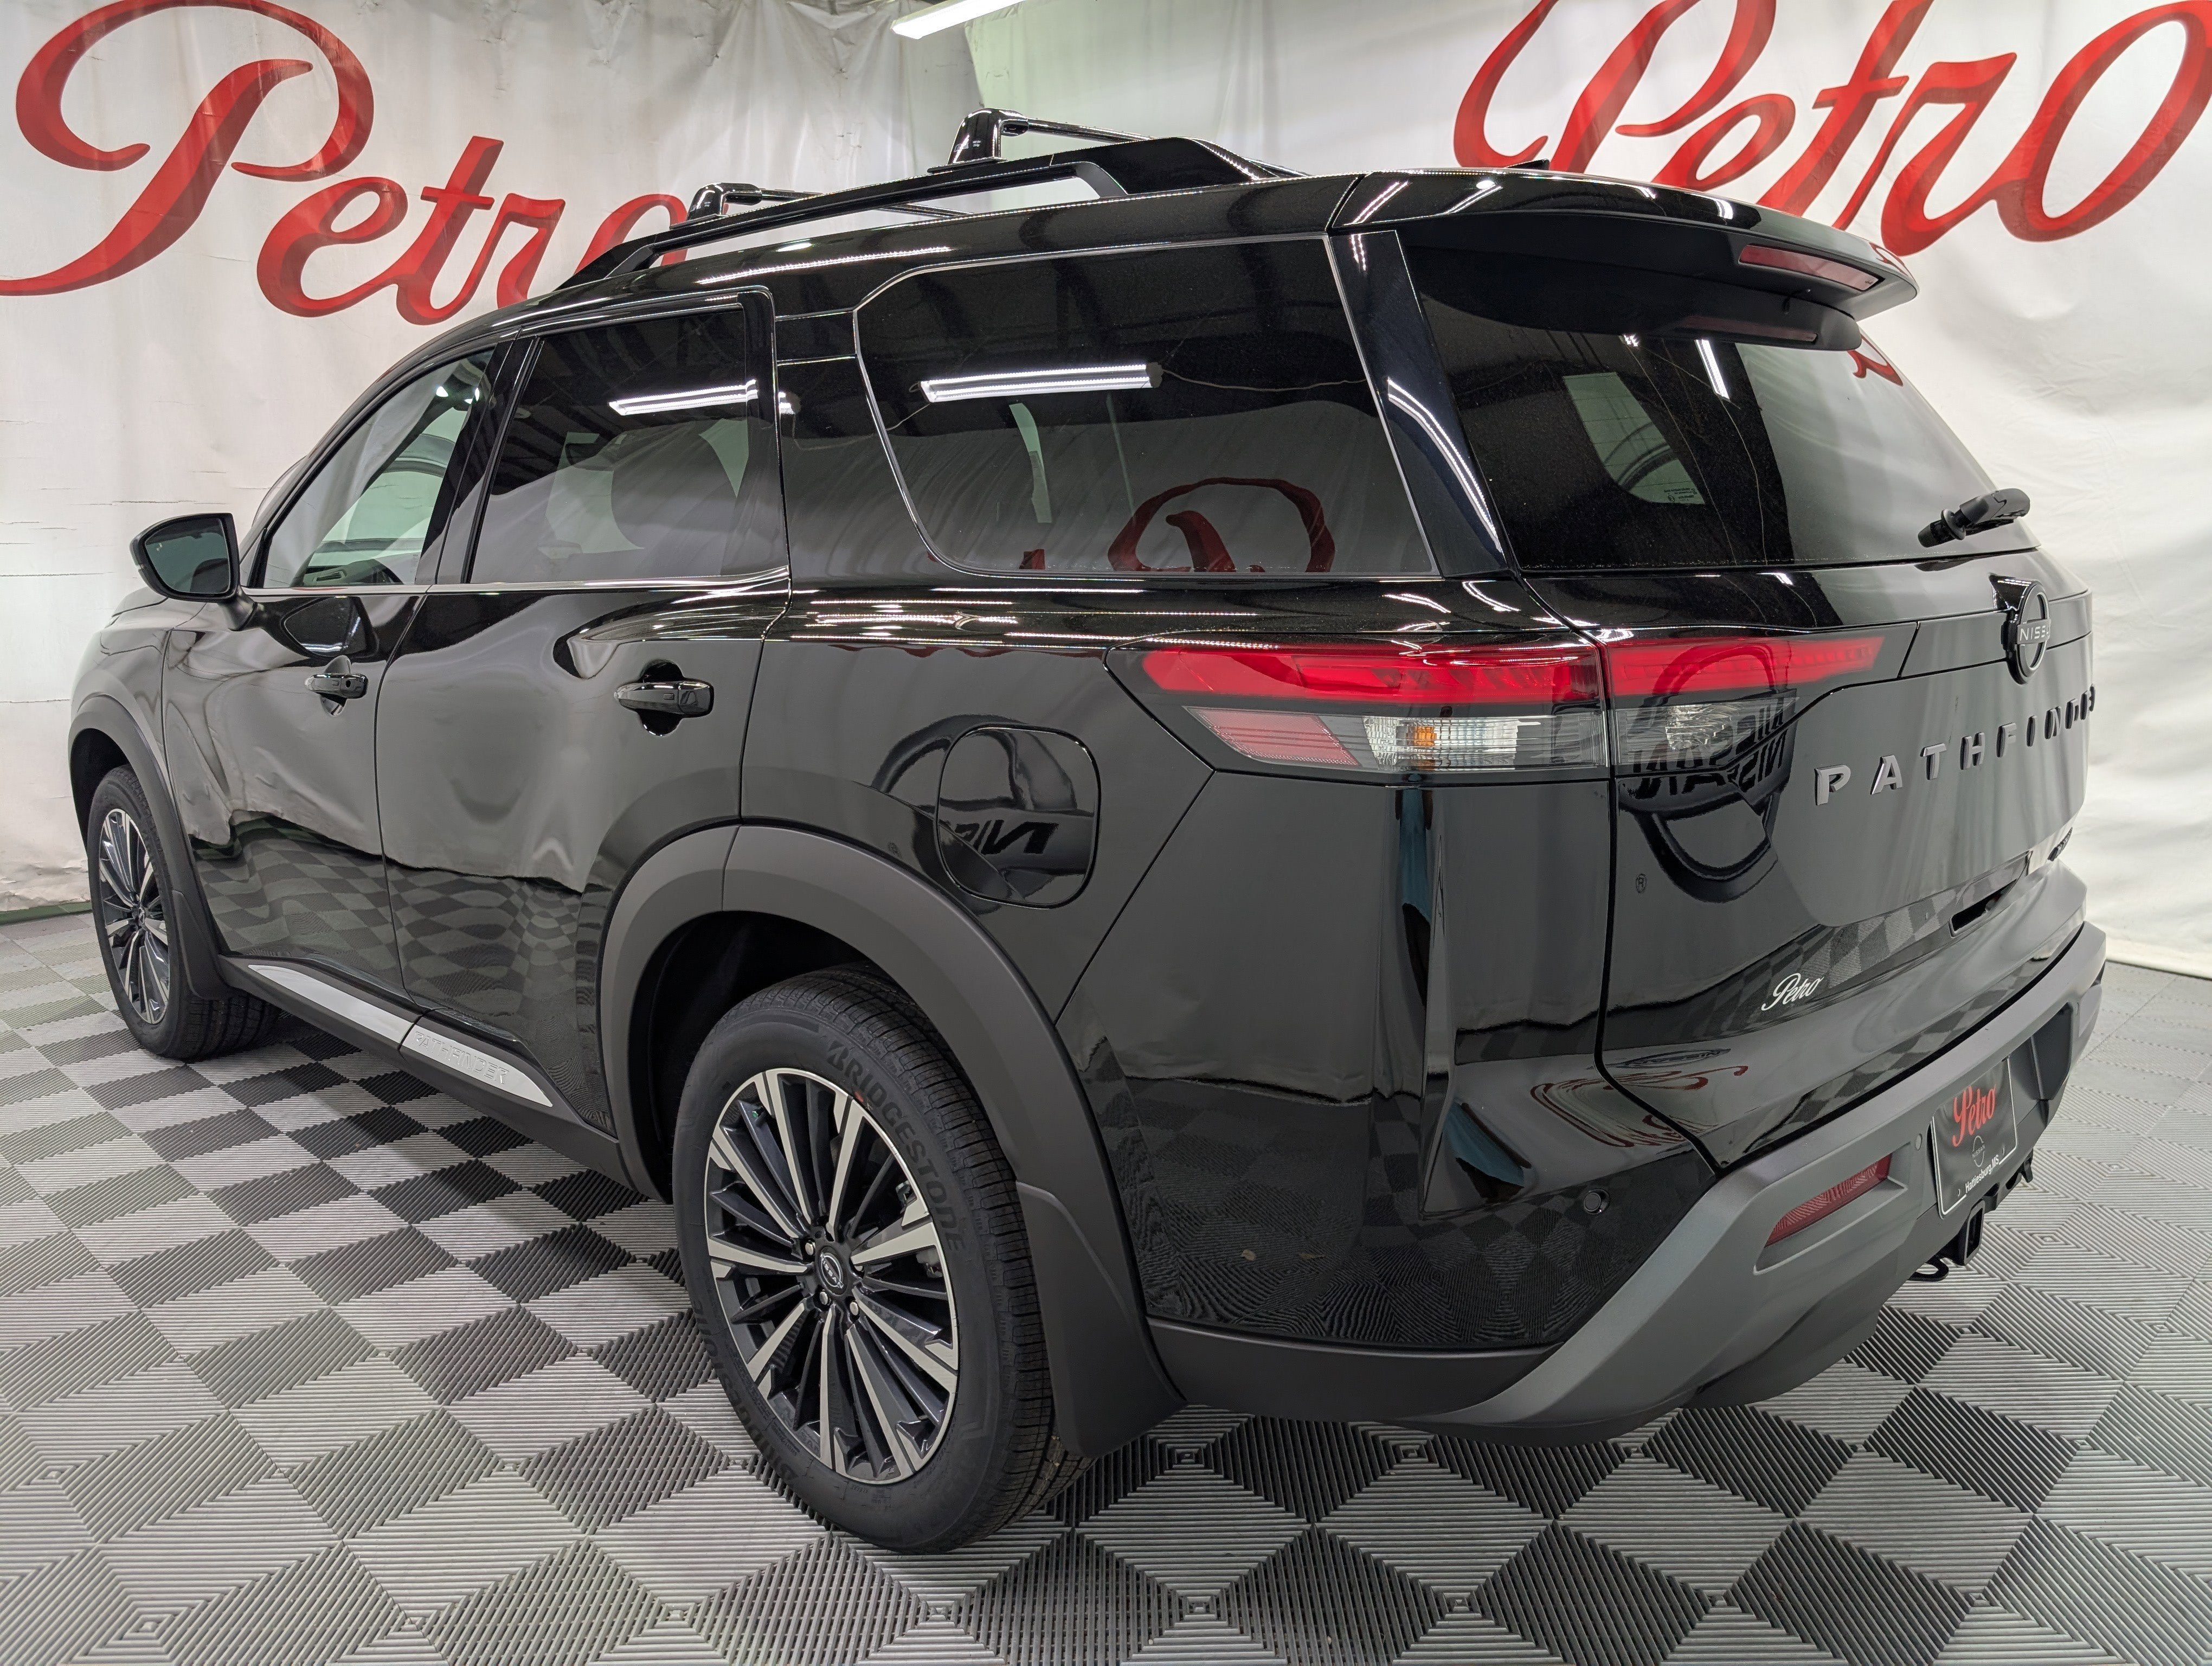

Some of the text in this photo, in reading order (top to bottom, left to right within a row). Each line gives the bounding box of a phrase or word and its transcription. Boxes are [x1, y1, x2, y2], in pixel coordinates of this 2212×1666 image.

[2018, 625, 2050, 642] NISS
[1761, 972, 1825, 1011] Petro
[413, 1031, 509, 1085] PATHFINDER
[1952, 1084, 1996, 1147] Petro
[825, 1040, 966, 1250] BRIDGESTONE
